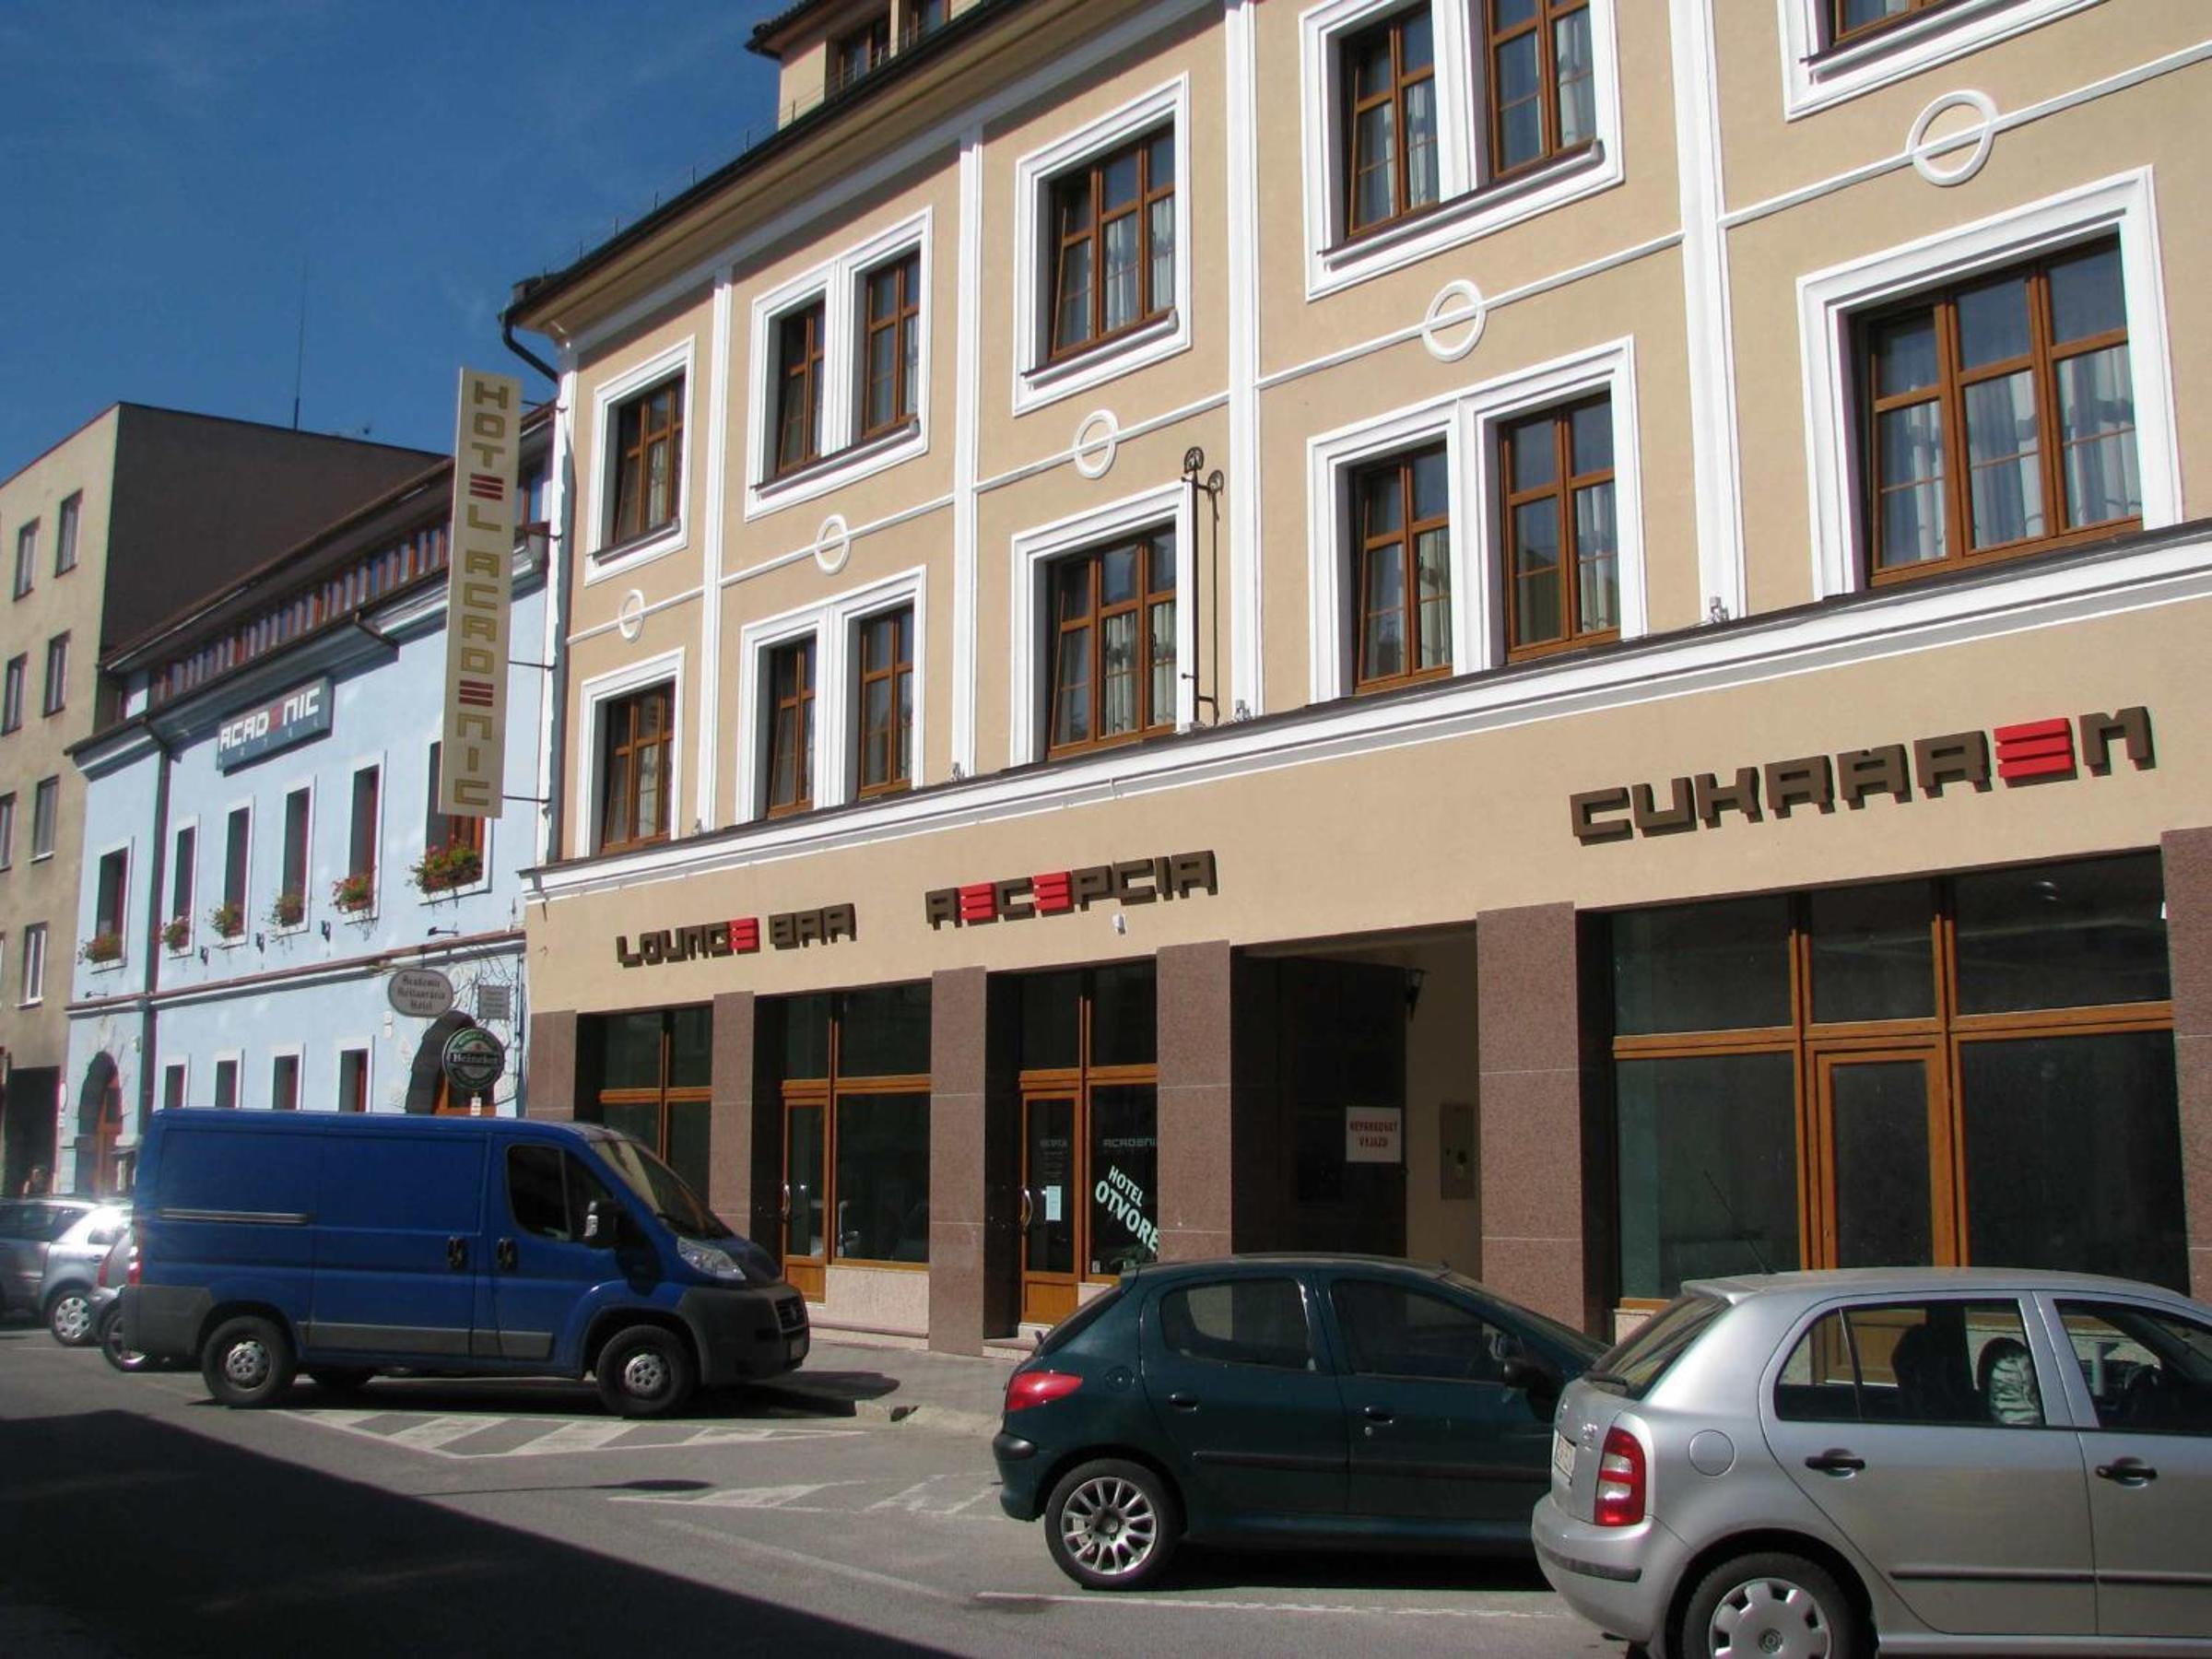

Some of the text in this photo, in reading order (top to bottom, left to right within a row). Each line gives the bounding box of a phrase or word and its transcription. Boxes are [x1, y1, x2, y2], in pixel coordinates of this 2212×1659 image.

[467, 381, 508, 531] HOTEL
[617, 903, 857, 968] LOUNGE BAR
[1095, 1181, 1159, 1253] OTVORE
[1108, 1165, 1144, 1207] HOTEL
